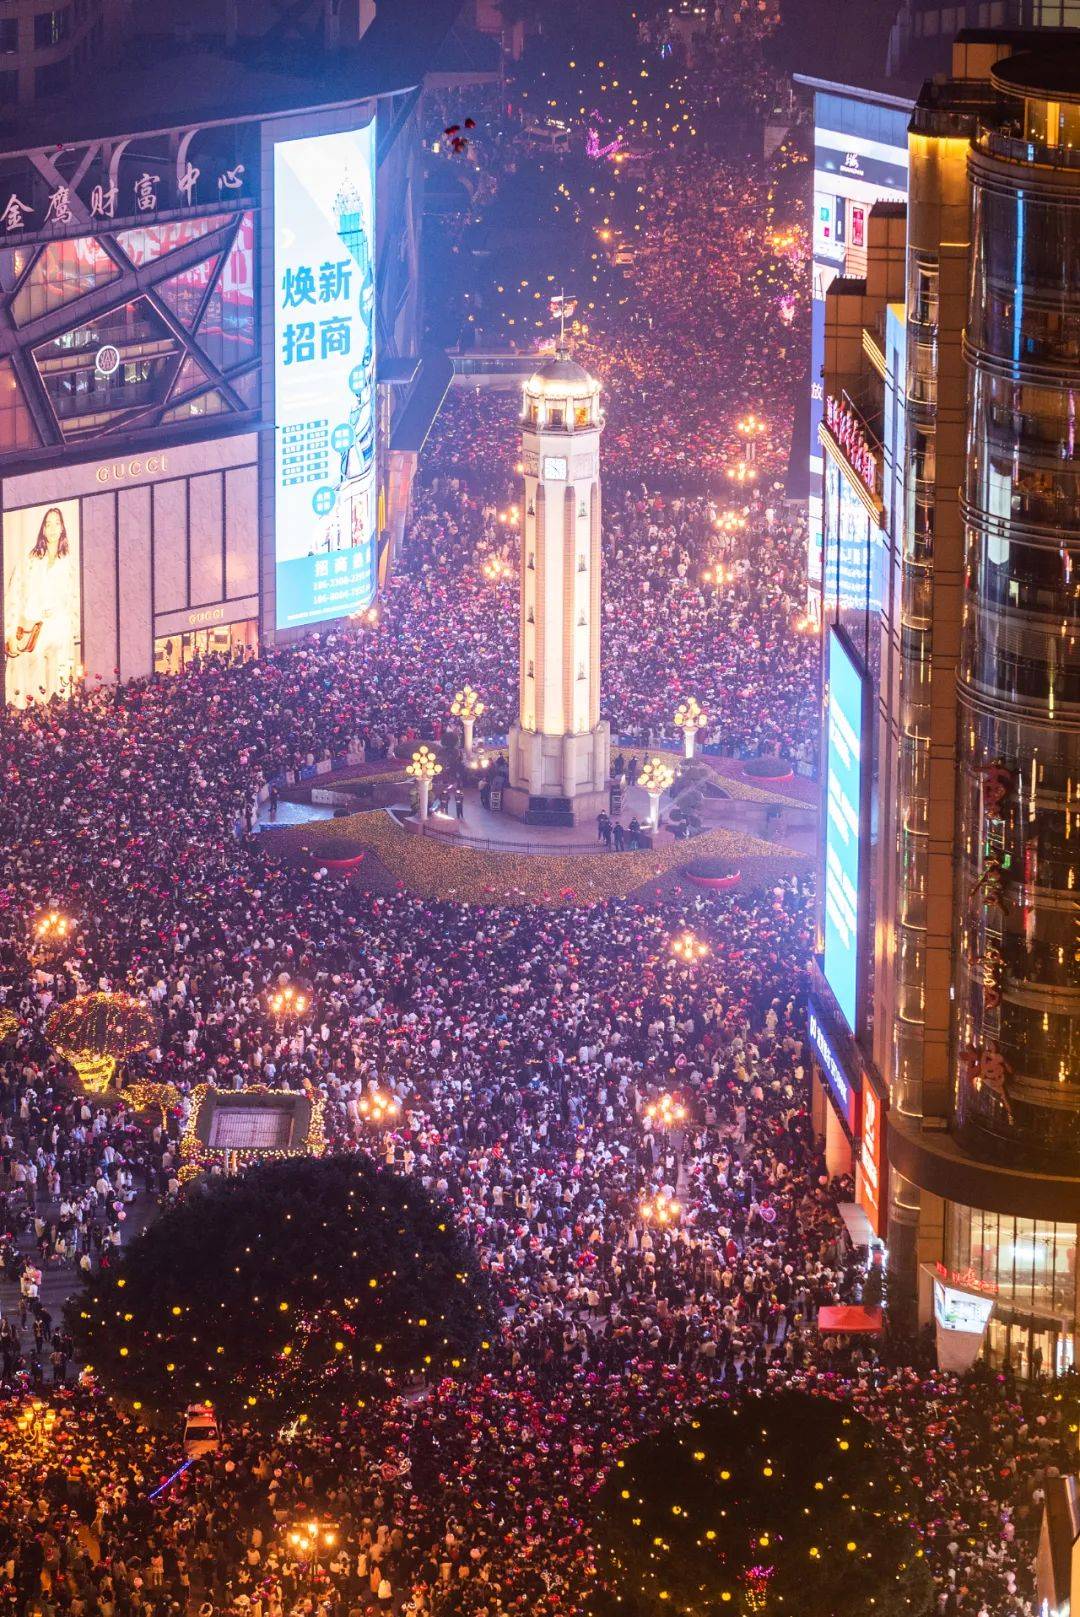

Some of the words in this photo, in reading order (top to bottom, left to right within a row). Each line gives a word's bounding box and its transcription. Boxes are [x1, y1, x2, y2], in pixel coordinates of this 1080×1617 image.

[1, 162, 245, 231] 金鹰财富中心
[282, 259, 352, 309] 焕新
[282, 316, 352, 365] 招商
[96, 455, 168, 482] GUCCI
[188, 609, 224, 624] GUCCI
